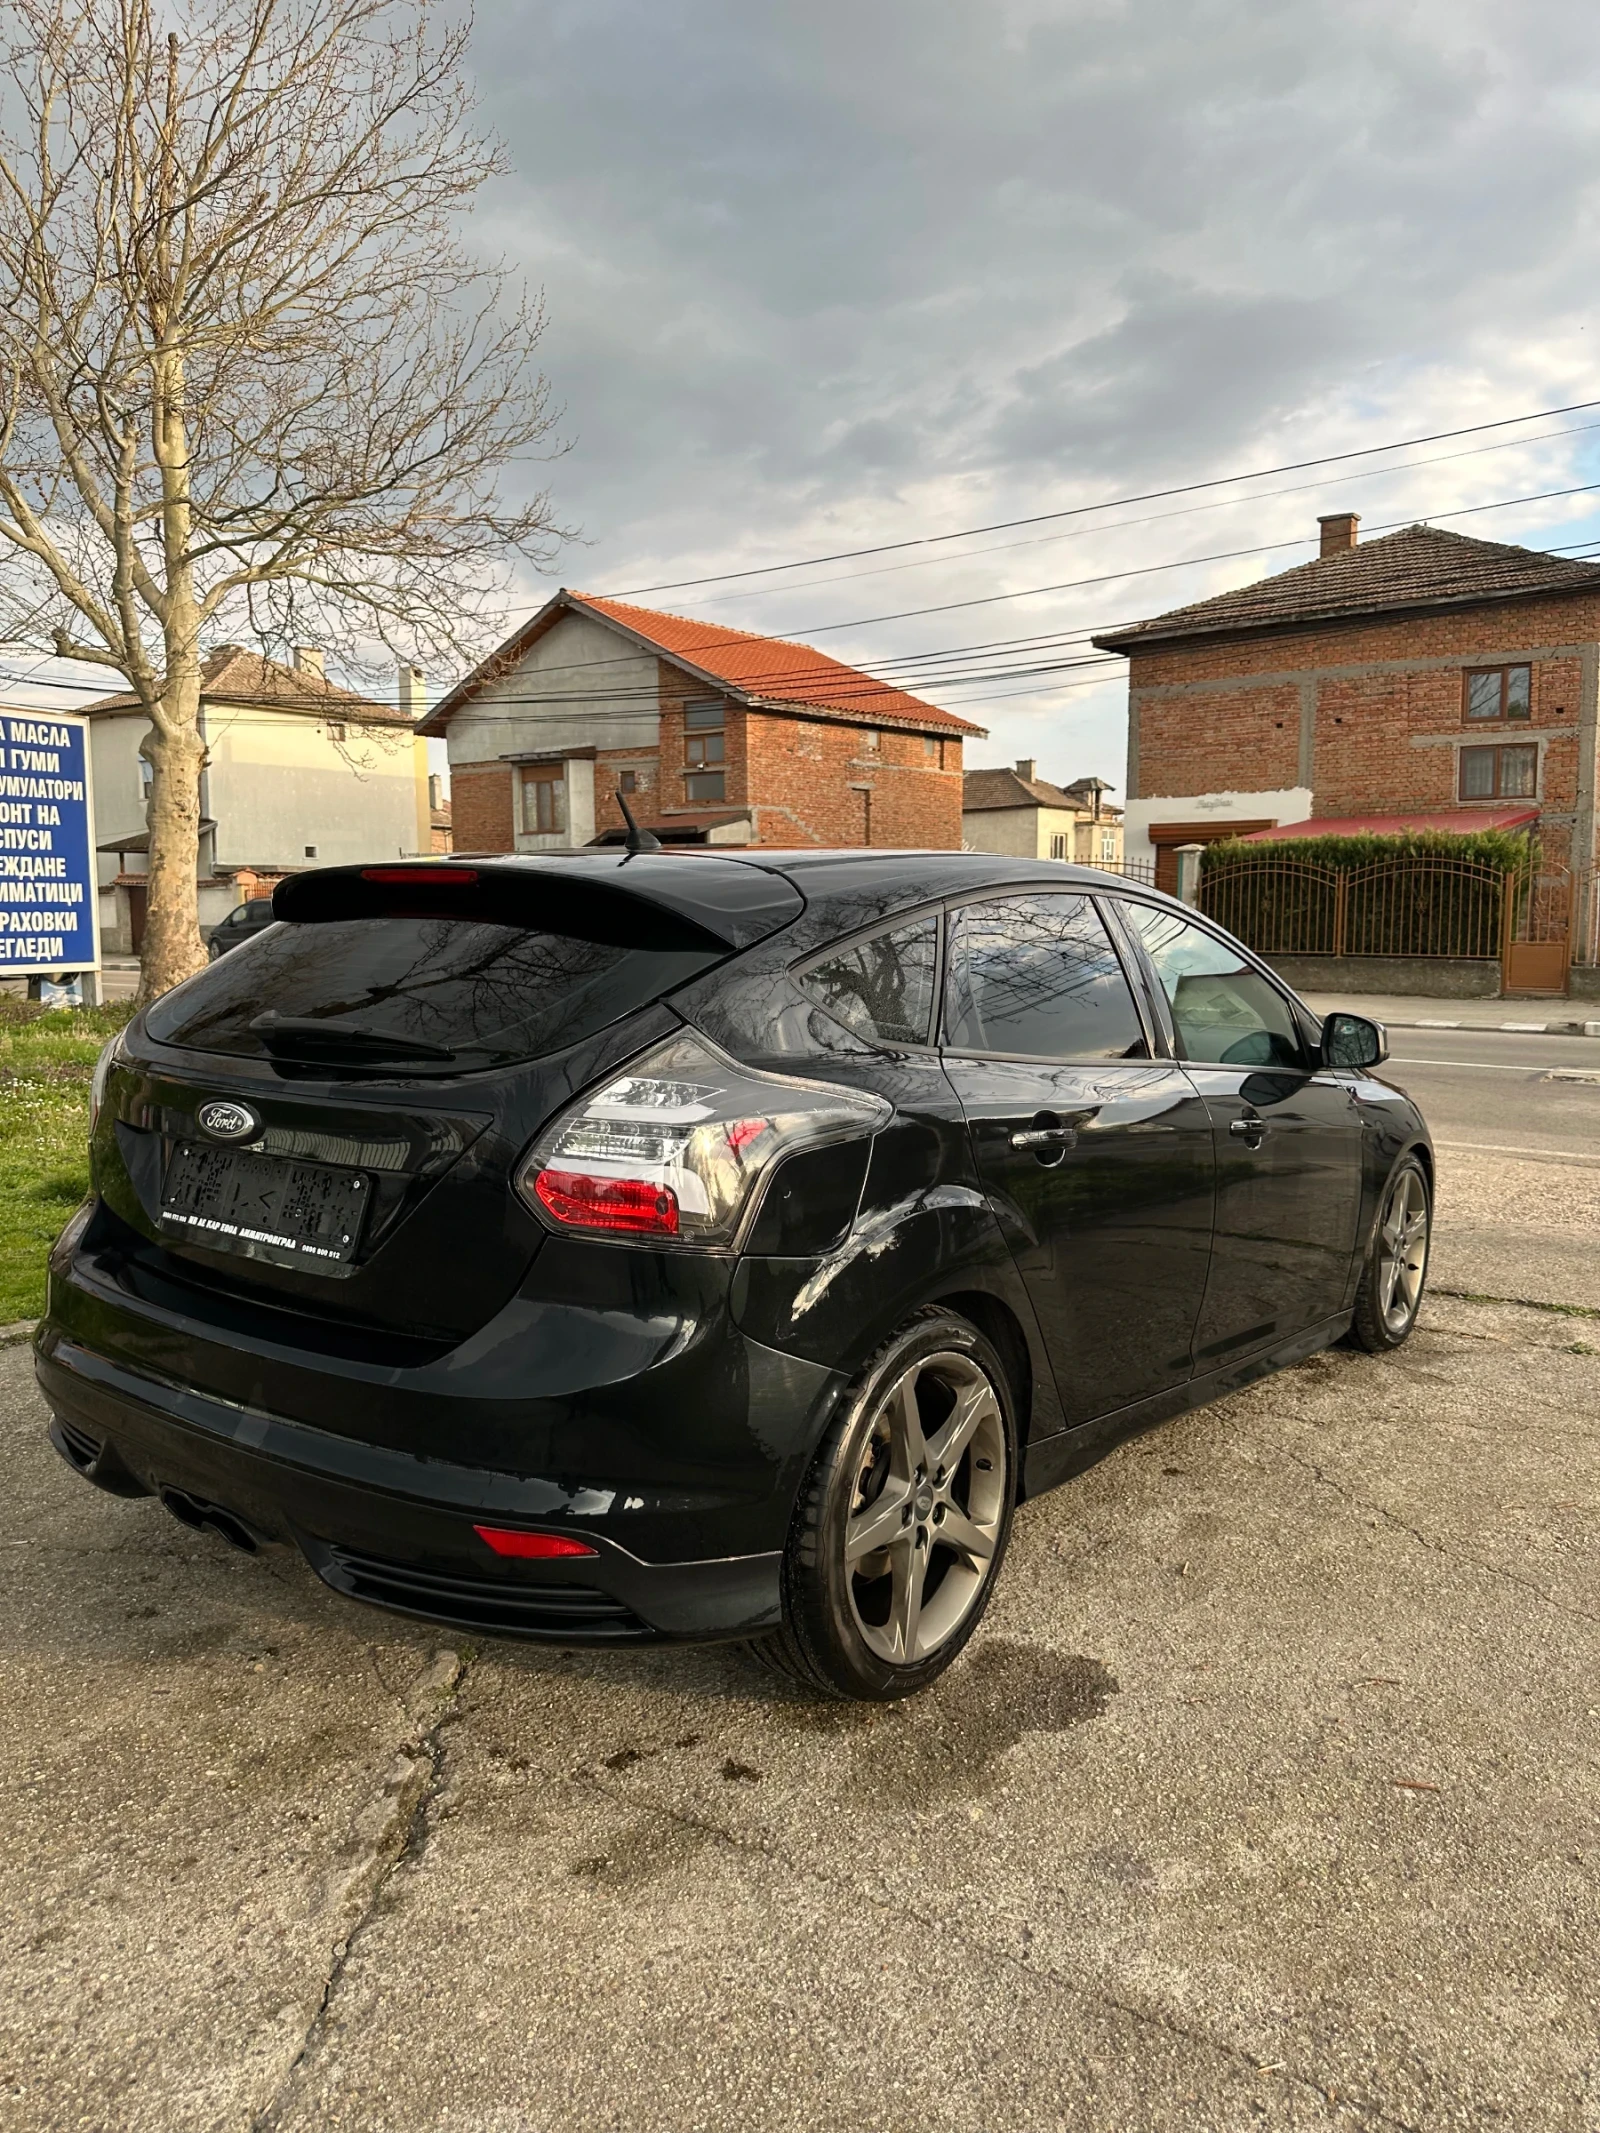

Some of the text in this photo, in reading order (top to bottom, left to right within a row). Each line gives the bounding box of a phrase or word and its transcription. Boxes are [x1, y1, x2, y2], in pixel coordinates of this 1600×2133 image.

[10, 721, 71, 748] МАСЛА
[10, 748, 60, 773] ГУМИ
[0, 775, 84, 801] УМУЛАТОРИ
[0, 802, 61, 826] ОНТ НА
[0, 882, 84, 906] ИМАТИЦИ
[0, 911, 78, 932] РАХОВКИ
[206, 1107, 238, 1130] Ford
[238, 1227, 297, 1249] ДИМИТРОВГРАД
